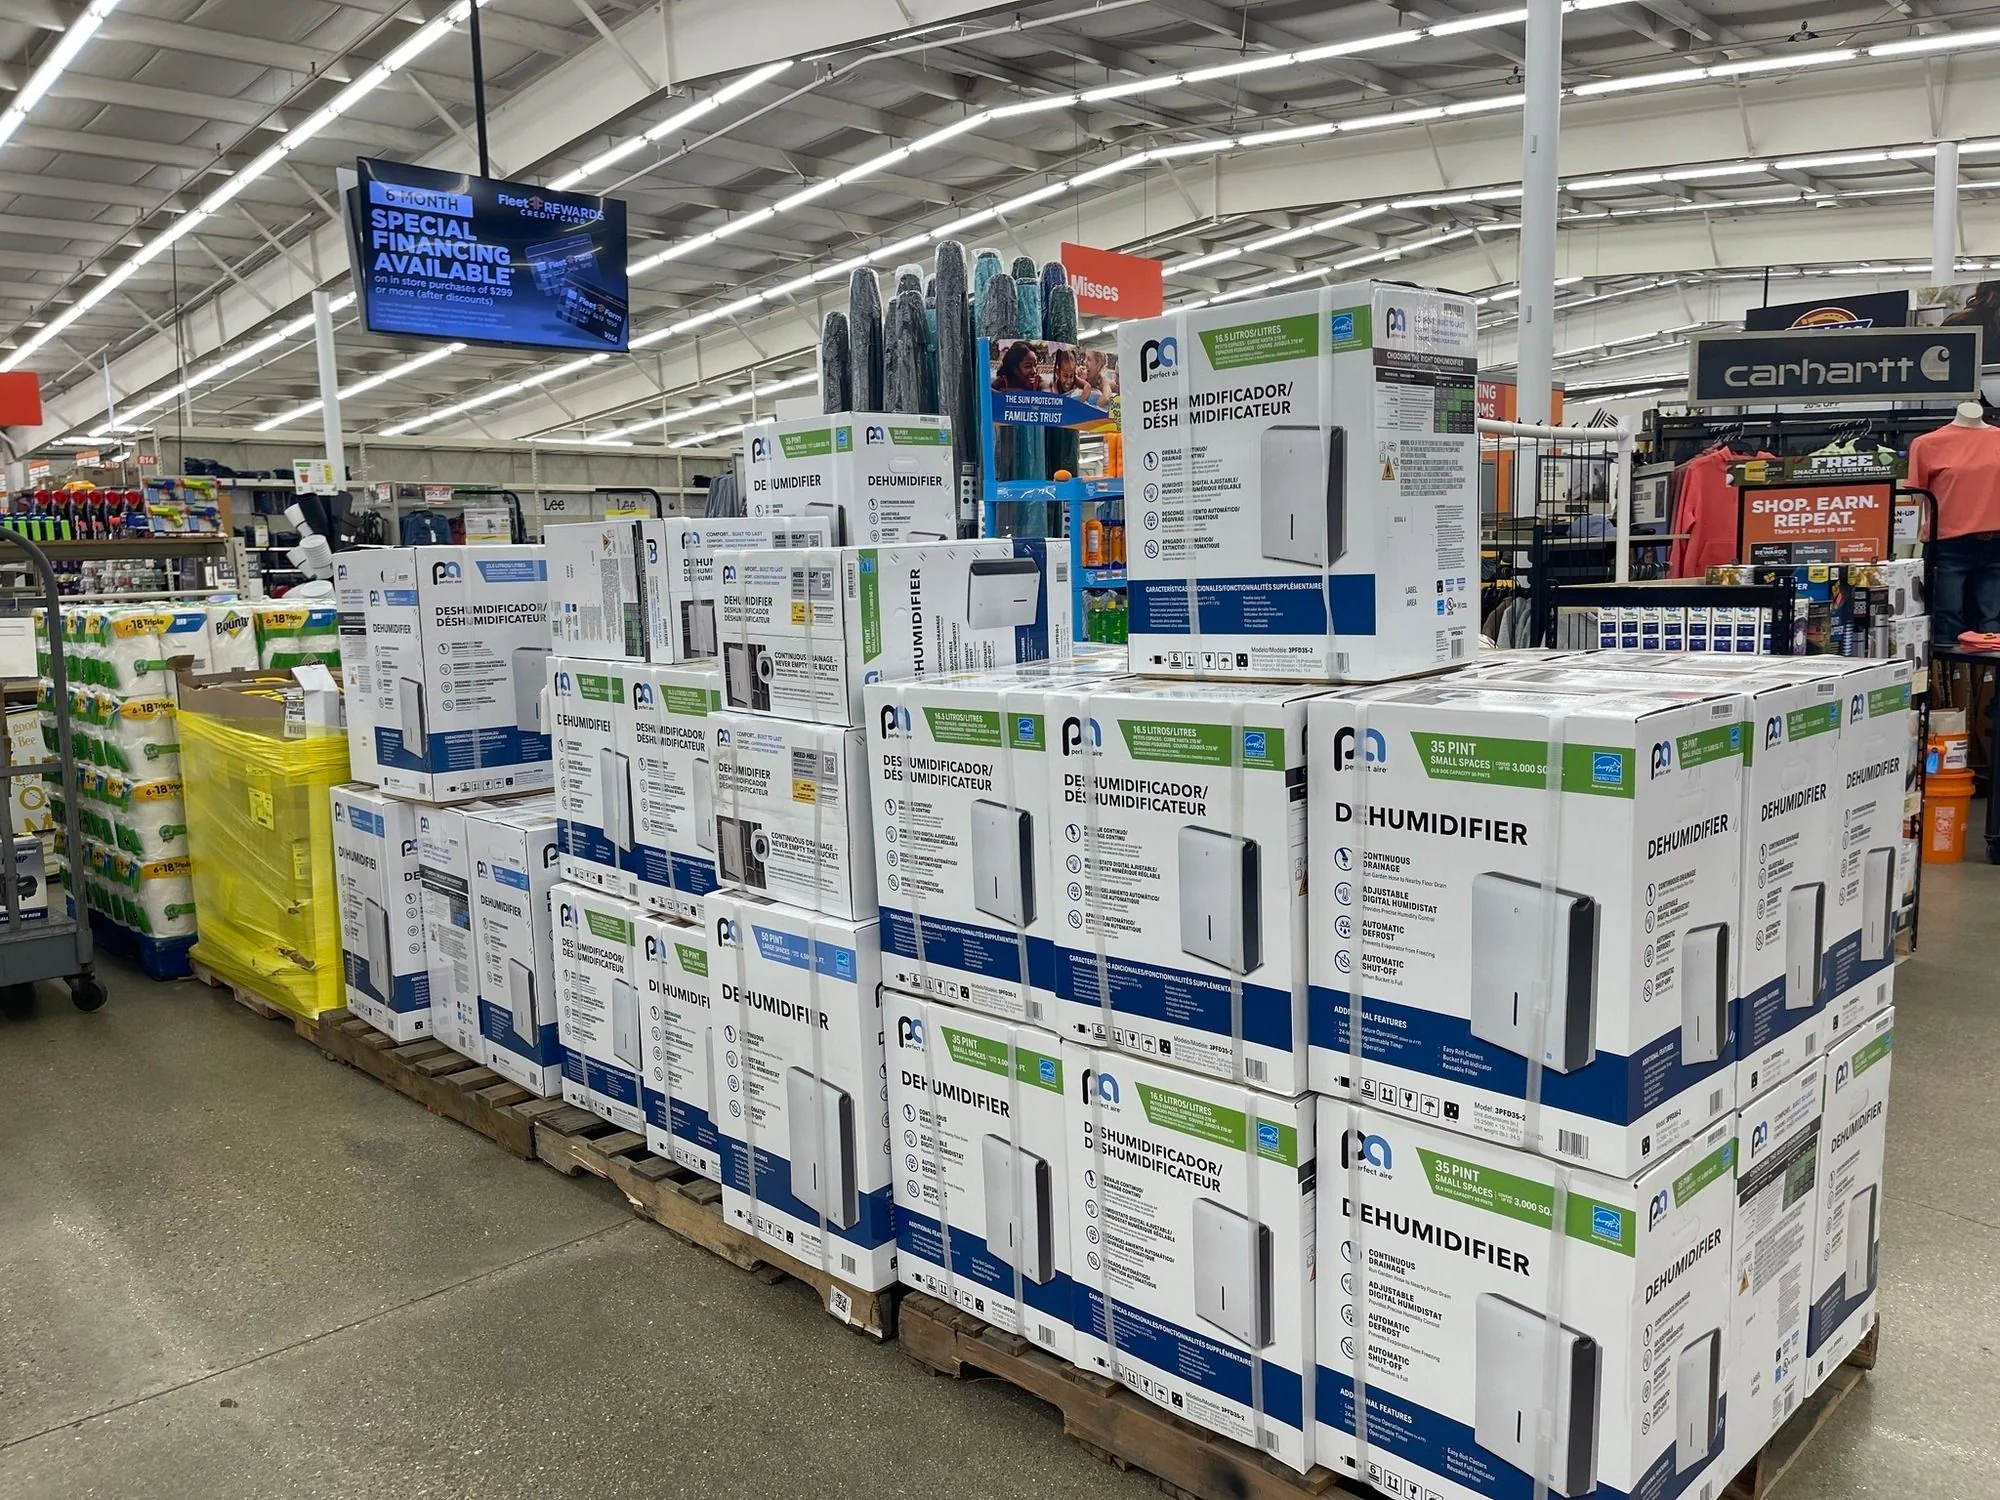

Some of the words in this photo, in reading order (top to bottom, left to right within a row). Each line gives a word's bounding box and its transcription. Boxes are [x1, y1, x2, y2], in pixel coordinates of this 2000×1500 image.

[386, 189, 396, 202] 6
[401, 191, 458, 212] MONTH
[498, 194, 529, 209] Fleet
[544, 202, 604, 220] REWARDS
[520, 209, 555, 220] CREDIT
[560, 216, 586, 224] CARD
[371, 210, 477, 241] SPECIAL
[373, 230, 511, 265] FINANCING
[391, 277, 400, 285] in
[402, 278, 426, 288] store
[429, 282, 476, 294] purchases
[490, 287, 513, 297] $299
[1071, 275, 1118, 302] Misses
[389, 288, 415, 297] more
[417, 289, 444, 301] (after
[446, 292, 494, 306] discounts)
[578, 296, 597, 311] Fleet
[604, 307, 622, 322] Farm
[604, 330, 618, 343] VISA
[1230, 325, 1281, 341] LITROS/LITRES
[1387, 352, 1411, 362] CHOOSING
[1411, 353, 1420, 362] THE
[1421, 355, 1434, 364] RIGHT
[1434, 356, 1464, 367] DEHUMIDIFIER
[1724, 357, 1914, 387] carhartt
[1006, 395, 1017, 403] THE
[1018, 396, 1030, 404] SUN
[1031, 397, 1063, 405] PROTECTION
[1142, 382, 1293, 413] DESHMIDIFICADOR/
[1004, 411, 1039, 422] FAMILIES
[1040, 413, 1062, 423] TRUST
[1143, 401, 1291, 430] DÉSHMIDIFICATEUR
[1811, 455, 1873, 469] FREE
[868, 476, 943, 487] DEHUMIDIFIER
[543, 497, 566, 512] Lee
[1752, 499, 1810, 513] SHOP.
[1816, 495, 1879, 510] EARN.
[1774, 511, 1856, 527] REPEAT.
[144, 618, 164, 626] Triple
[216, 615, 249, 636] Bounty
[373, 624, 411, 634] DEHUMIDIFIER
[774, 652, 807, 661] CONTINUOUS
[775, 660, 791, 668] NEVER
[792, 661, 808, 669] EMPTY
[819, 664, 838, 672] BUCKET
[13, 718, 38, 735] good
[1133, 725, 1146, 735] 16.5
[1147, 726, 1197, 737] LITROS/LITRES
[18, 737, 37, 746] Bee
[1431, 740, 1445, 753] 35
[1448, 742, 1476, 756] PINT
[883, 754, 993, 777] DESUMIDIFICADOR/
[1431, 756, 1457, 767] SMALL
[1459, 758, 1490, 769] SPACES
[1512, 763, 1535, 774] 3,000
[884, 767, 993, 791] DÉSUMIDIFICATEUR
[1846, 756, 1900, 790] DEHUMIDIFIER
[1761, 783, 1827, 823] DEHUMIDIFIER
[1335, 802, 1528, 846] DHUMIDIFIER
[771, 832, 804, 845] CONTINUOUS
[1647, 813, 1729, 860] DEHUMIDIFIER
[772, 840, 788, 850] NEVER
[789, 843, 806, 853] EMPTY
[1363, 851, 1411, 865] CONTINUOUS
[1363, 861, 1400, 872] DRAINAGE
[1363, 886, 1409, 900] ADJUSTABLE
[481, 895, 522, 918] DEHUMIDIFIER
[1363, 894, 1391, 906] DIGITAL
[1392, 899, 1438, 914] HUMIDISTAT
[1362, 920, 1405, 934] AUTOMATIC
[1362, 928, 1395, 941] DEFROST
[762, 931, 769, 941] 50
[770, 934, 783, 945] PINT
[682, 948, 689, 959] 35
[689, 950, 699, 961] PINT
[762, 942, 776, 952] LARGE
[1362, 953, 1404, 969] AUTOMATIC
[1362, 962, 1397, 976] SHUT-OFF
[1374, 1014, 1407, 1029] FEATURES
[952, 1034, 960, 1045] 35
[961, 1036, 978, 1050] PINT
[953, 1045, 968, 1055] SMALL
[968, 1049, 987, 1060] SPACES
[1443, 1045, 1454, 1054] Easy
[1455, 1048, 1464, 1057] Roll
[1464, 1051, 1484, 1061] Casters
[1442, 1063, 1464, 1073] Reusable
[1465, 1068, 1478, 1076] Filter
[1443, 1054, 1459, 1063] Bucket
[1460, 1058, 1470, 1066] Full
[1470, 1061, 1492, 1072] Indicator
[1150, 1091, 1163, 1102] 16.5
[1163, 1096, 1212, 1116] LITROS/LITRES
[1474, 1101, 1493, 1114] Model:
[1494, 1107, 1526, 1122] 3PFD35-2
[1831, 1100, 1882, 1154] DEHUMIDIFIER
[1084, 1121, 1223, 1177] DSHUMIDIFICADOR/
[1084, 1136, 1221, 1193] DSHUMIDIFICATEUR
[1435, 1160, 1450, 1173] 35
[1452, 1164, 1480, 1183] PINT
[1379, 1170, 1393, 1180] aire
[1435, 1174, 1462, 1189] SMALL
[1462, 1182, 1493, 1198] SPACES
[1453, 1190, 1475, 1200] CAPACITY
[1514, 1197, 1537, 1212] 3,000
[1368, 1248, 1416, 1270] CONTINUOUS
[1368, 1257, 1406, 1276] DRAINAGE
[1645, 1228, 1722, 1305] DEHUMIDIFIER
[1368, 1280, 1414, 1302] ADJUSTABLE
[1368, 1288, 1396, 1305] DIGITAL
[1398, 1300, 1442, 1321] HUMIDISTAT
[1368, 1312, 1410, 1333] AUTOMATIC
[1368, 1320, 1400, 1338] DEFROST
[1368, 1344, 1410, 1366] AUTOMATIC
[1368, 1352, 1403, 1371] SHUT-OFF
[1380, 1404, 1413, 1424] FEATURES
[1447, 1447, 1459, 1458] Easy
[1459, 1452, 1468, 1461] Roll
[1468, 1456, 1487, 1469] Casters
[1447, 1455, 1463, 1467] Bucket
[1464, 1463, 1473, 1472] Full
[1473, 1467, 1495, 1481] Indicator
